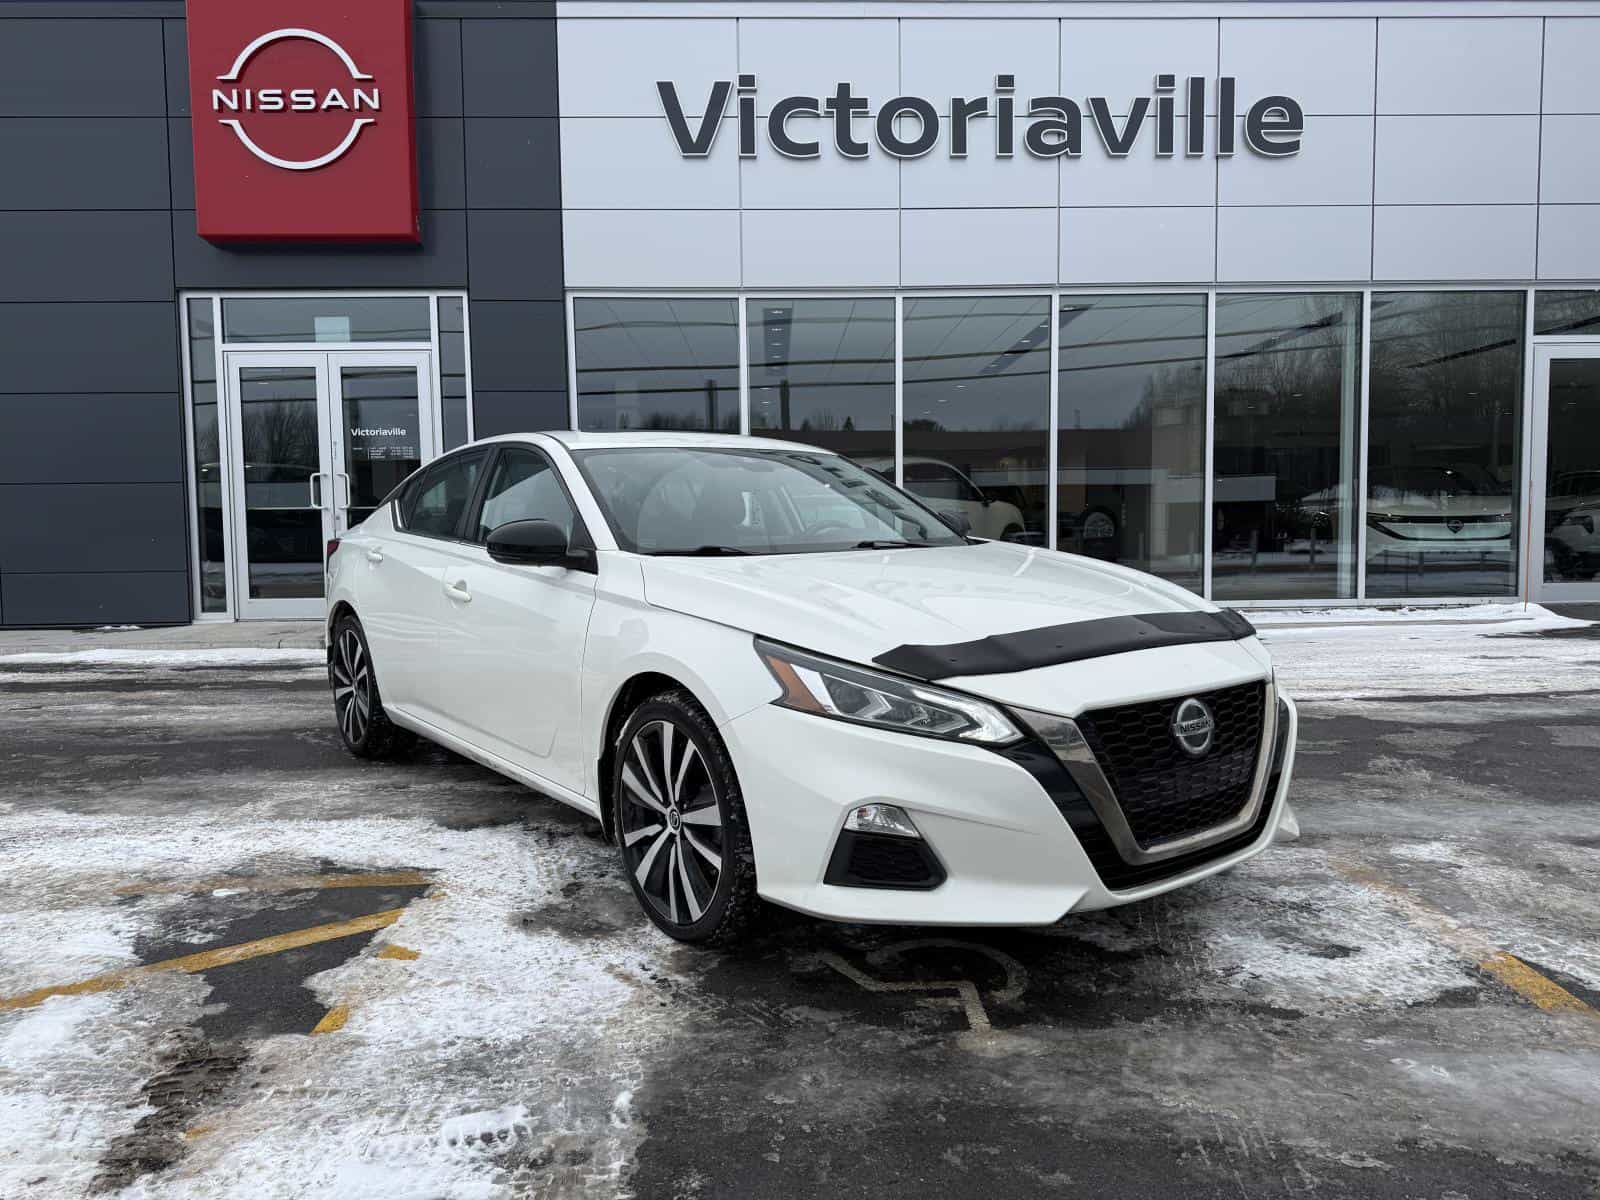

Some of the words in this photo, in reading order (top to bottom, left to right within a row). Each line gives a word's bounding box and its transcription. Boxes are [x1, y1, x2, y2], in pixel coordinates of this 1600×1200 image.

[212, 88, 380, 111] NISSAN
[655, 73, 1306, 158] Victoriaville
[351, 428, 406, 436] Victoriaville
[1180, 719, 1211, 733] NISSAN
